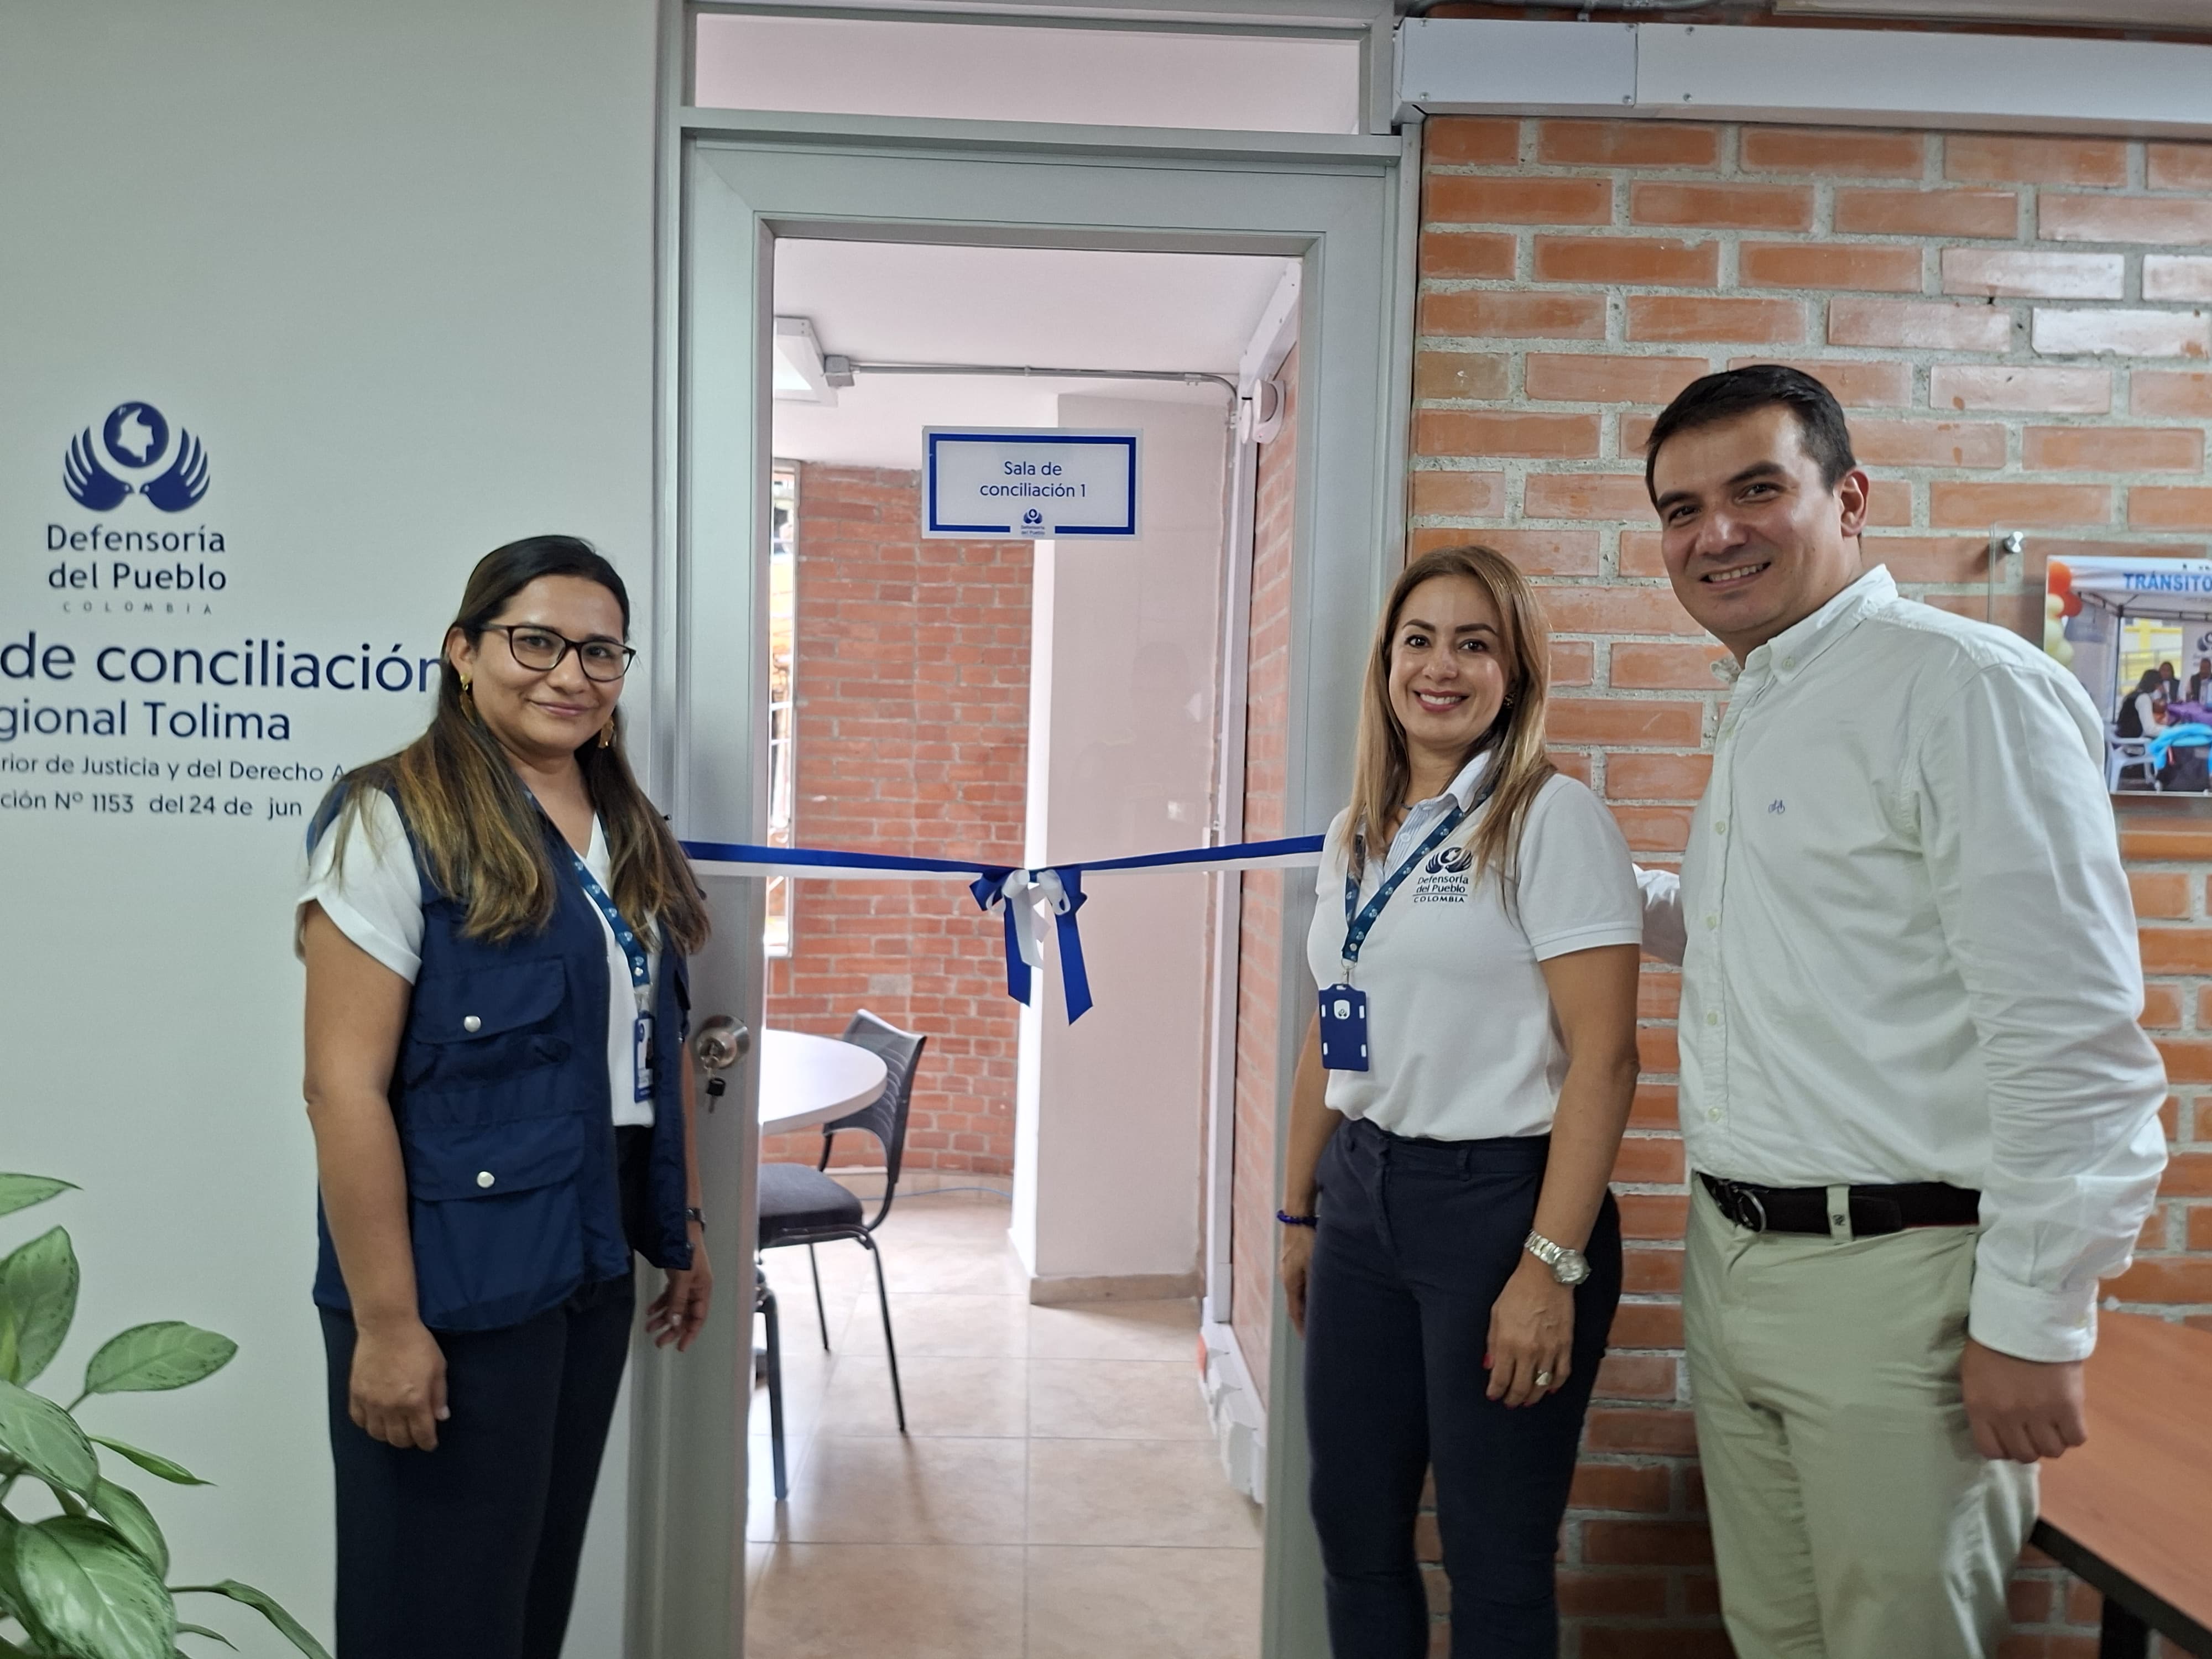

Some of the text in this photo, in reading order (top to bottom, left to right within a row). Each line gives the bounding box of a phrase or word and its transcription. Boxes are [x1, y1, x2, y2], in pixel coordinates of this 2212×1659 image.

[1004, 461, 1062, 476] Sala de
[979, 482, 1086, 497] conciliación 1
[47, 523, 226, 552] Defensoría
[48, 562, 227, 591] del Pueblo
[2124, 571, 2212, 592] TRÁNSITO
[63, 602, 212, 614] COLOMBIA
[0, 630, 441, 692] de conciliación
[143, 701, 290, 741] Tolima
[2, 753, 38, 773] rior
[45, 755, 75, 774] de
[82, 755, 159, 776] Justicia
[168, 762, 180, 781] y
[187, 759, 221, 779] del
[230, 761, 324, 781] Derecho
[1, 790, 46, 809] ción
[92, 794, 134, 813] 1153
[149, 794, 184, 814] del
[190, 795, 216, 815] 24
[224, 796, 253, 816] de
[268, 797, 302, 821] jun
[1416, 883, 1465, 893] del Pueblo
